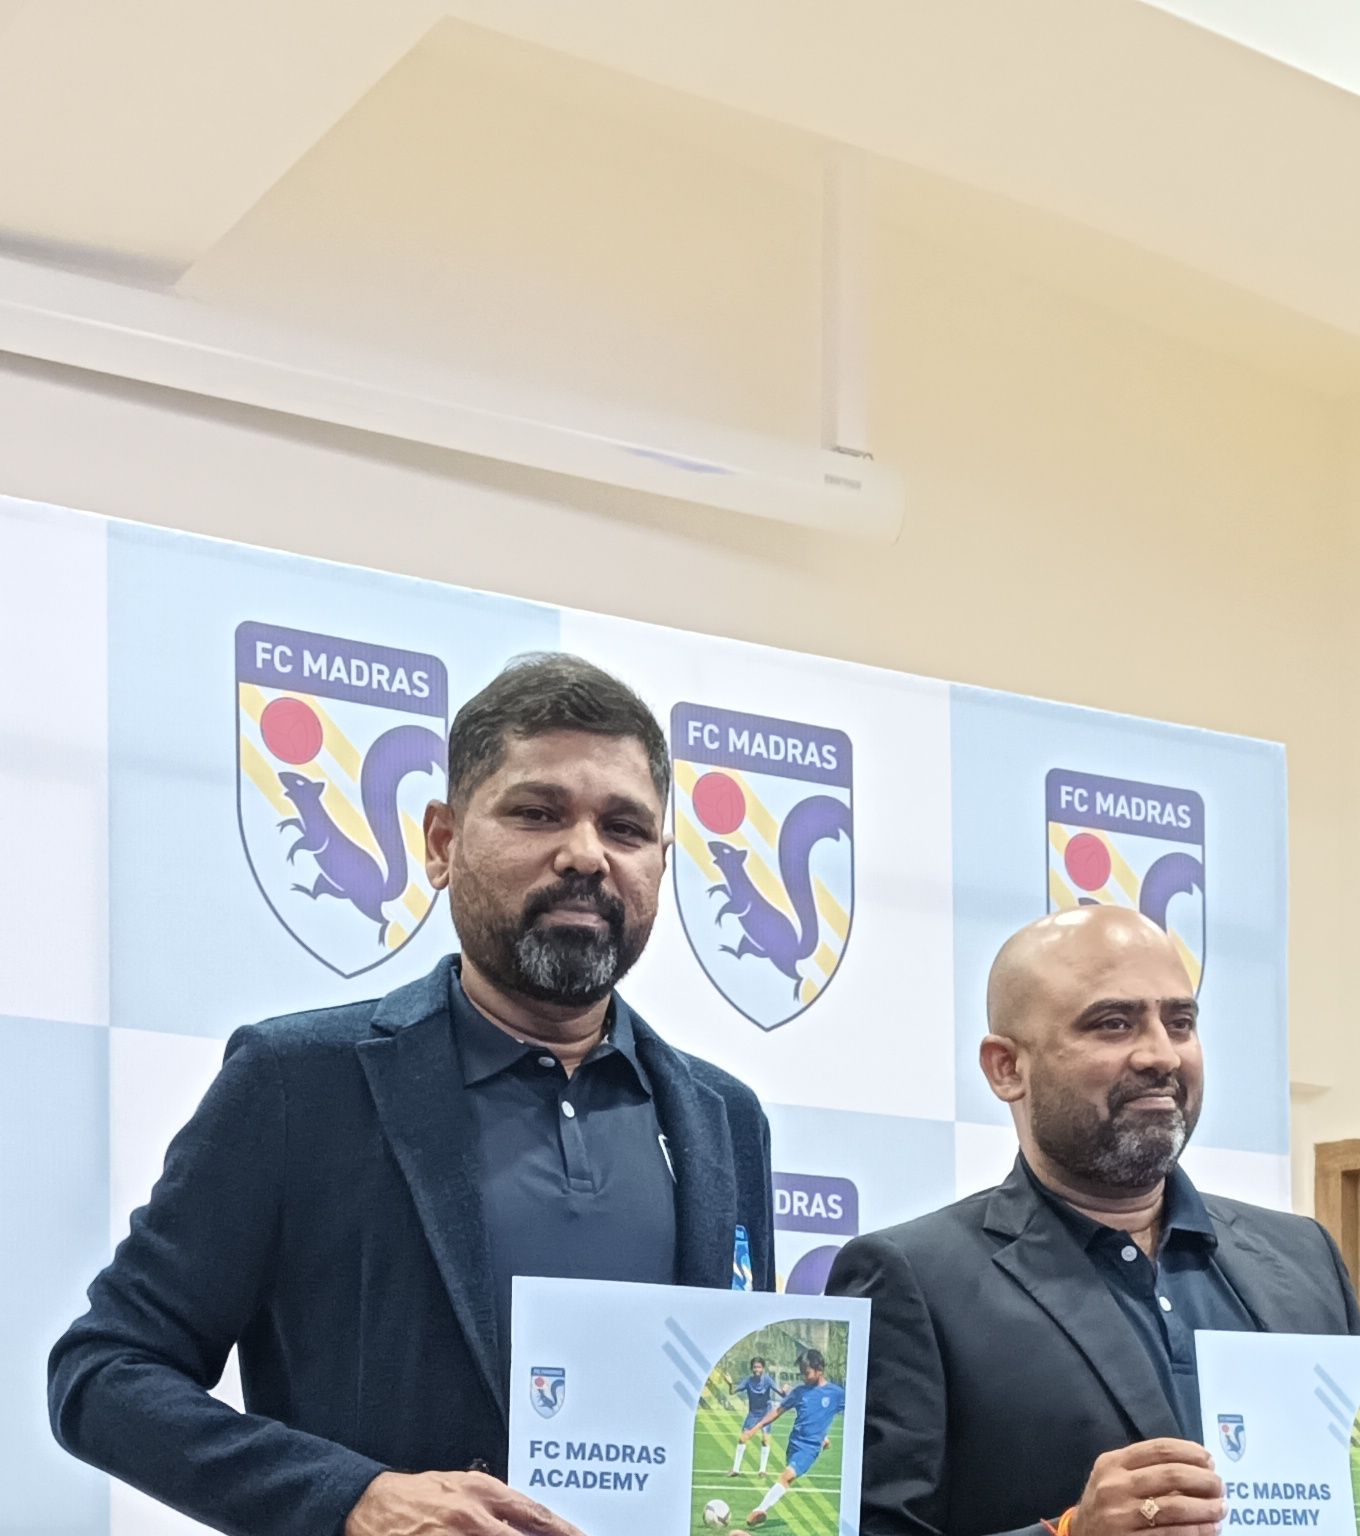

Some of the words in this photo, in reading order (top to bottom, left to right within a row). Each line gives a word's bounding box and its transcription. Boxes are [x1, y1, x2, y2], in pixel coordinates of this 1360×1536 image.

[255, 640, 293, 674] FC
[303, 649, 430, 698] MADRAS
[688, 720, 720, 750] FC
[728, 727, 837, 770] MADRAS
[1060, 785, 1089, 813] FC
[1095, 791, 1192, 829] MADRAS
[773, 1188, 844, 1220] DRAS
[529, 1440, 561, 1460] FC
[565, 1441, 666, 1465] MADRAS
[528, 1468, 649, 1492] ACADEMY
[1225, 1482, 1250, 1500] FC
[1252, 1482, 1332, 1501] MADRAS
[1229, 1508, 1320, 1526] ACADEMY
